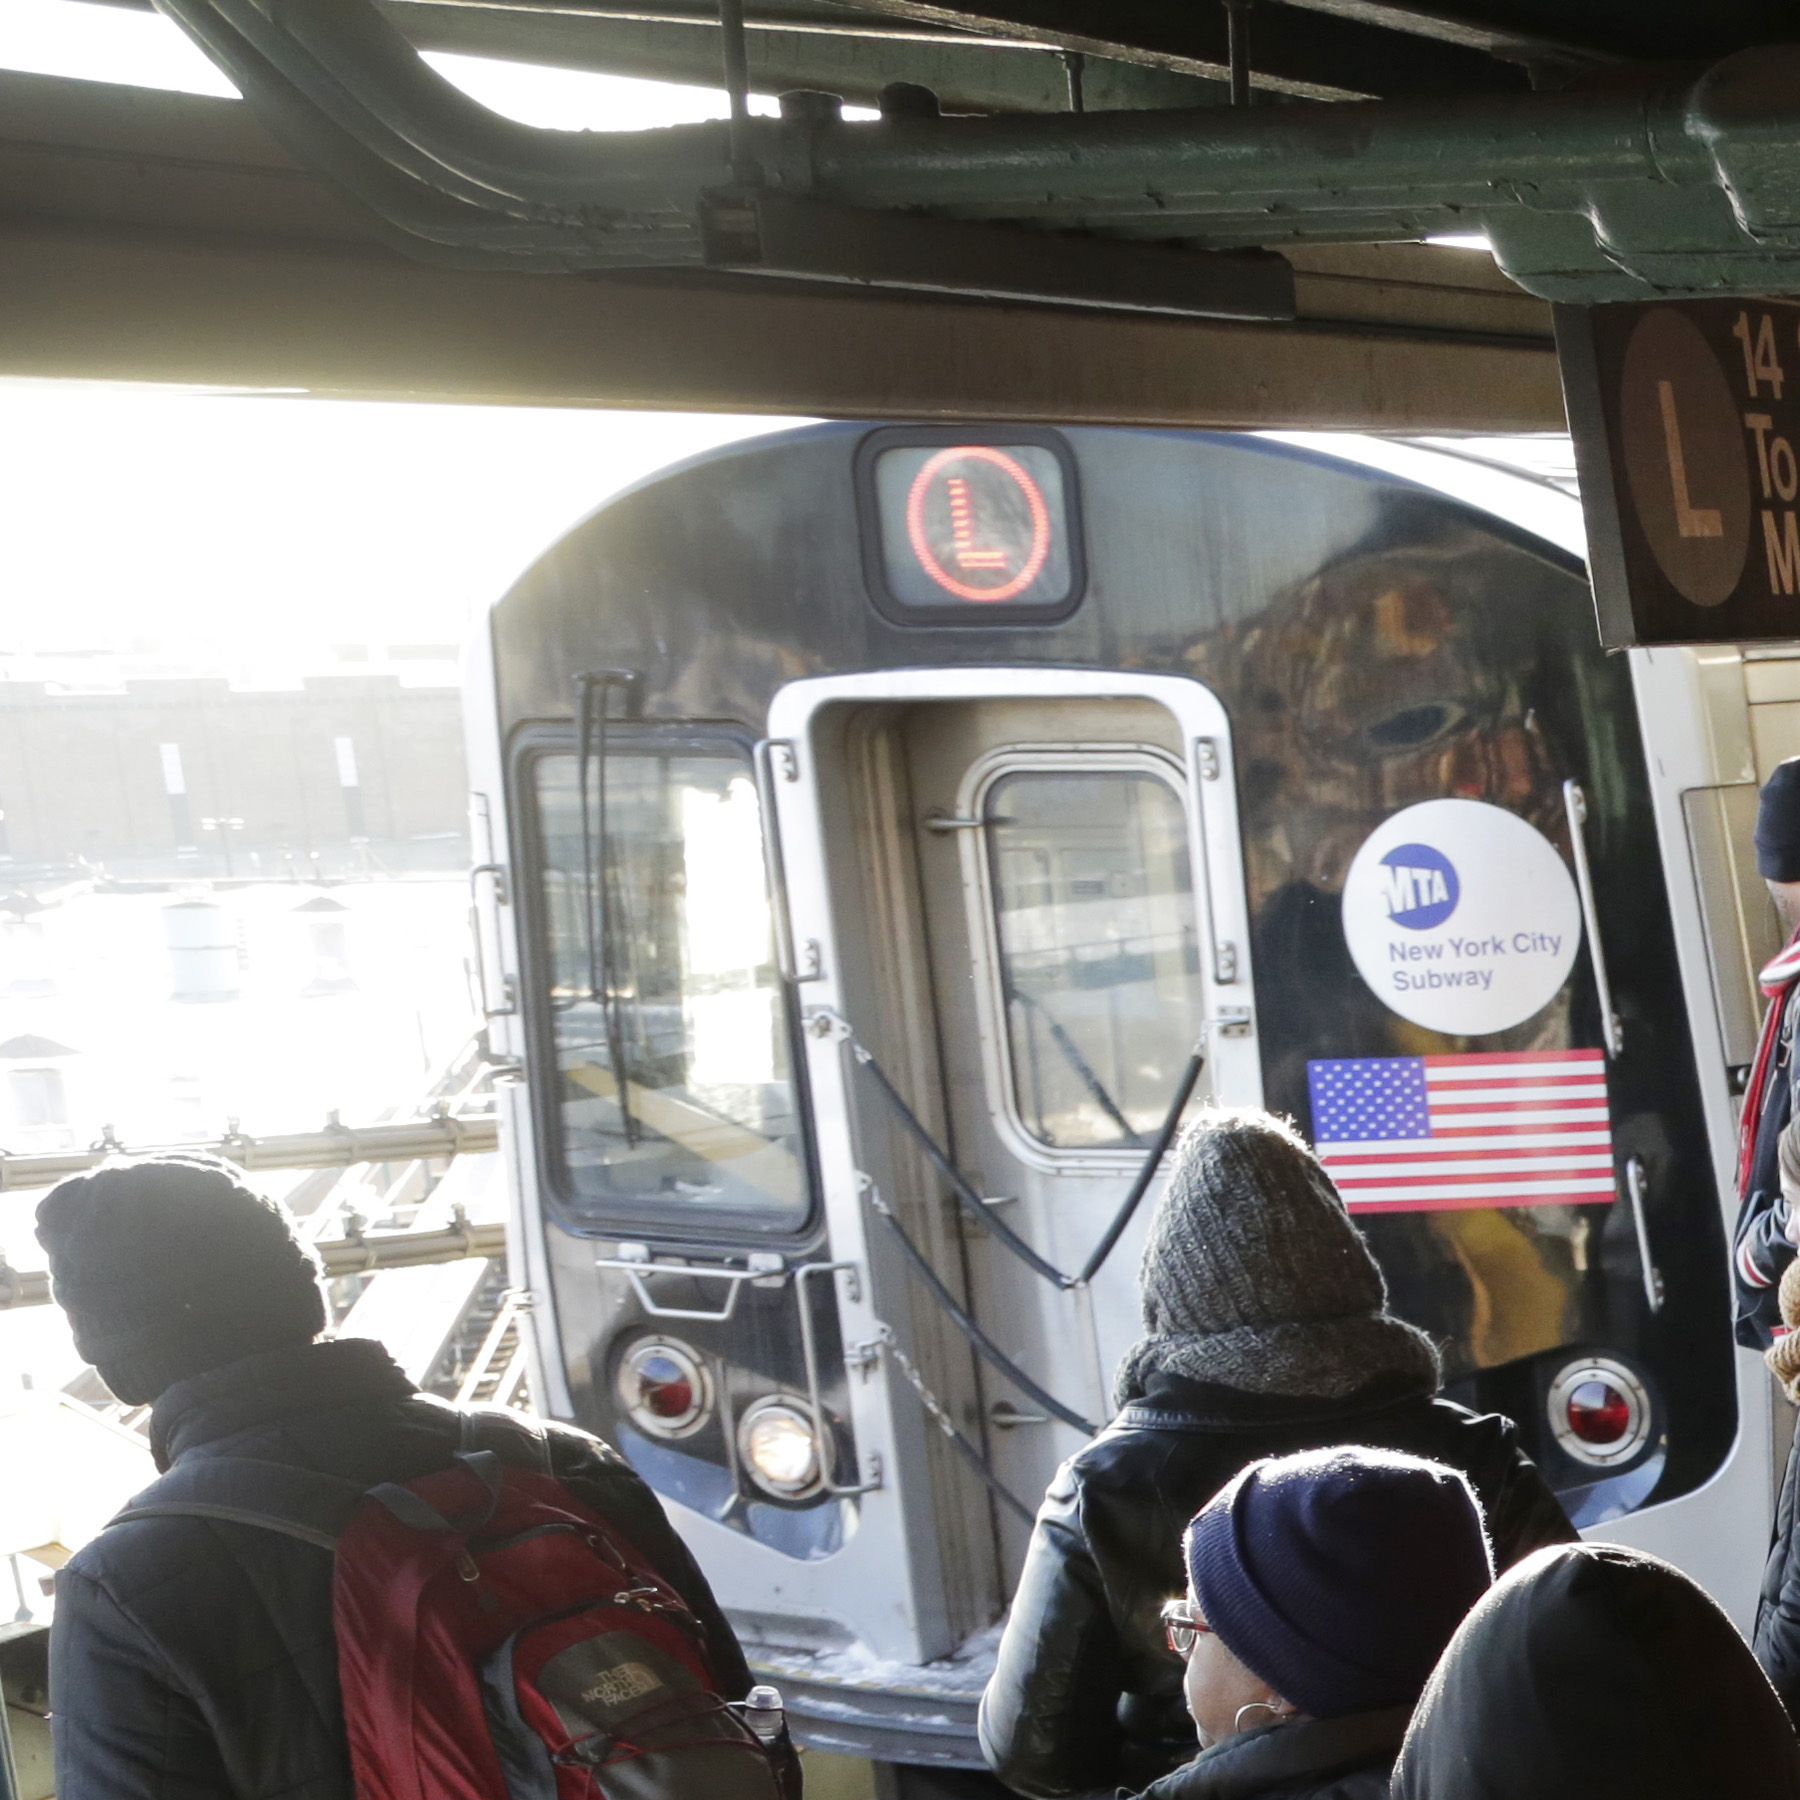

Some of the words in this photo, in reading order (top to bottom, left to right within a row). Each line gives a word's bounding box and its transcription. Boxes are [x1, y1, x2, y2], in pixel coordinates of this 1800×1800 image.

[1733, 312, 1783, 399] 14
[1657, 380, 1724, 538] L
[1745, 412, 1797, 500] To
[948, 478, 1006, 568] L
[1379, 863, 1450, 914] MTA
[1388, 941, 1444, 963] New
[1449, 936, 1507, 959] York
[1512, 932, 1562, 956] City
[1392, 969, 1494, 991] Subway
